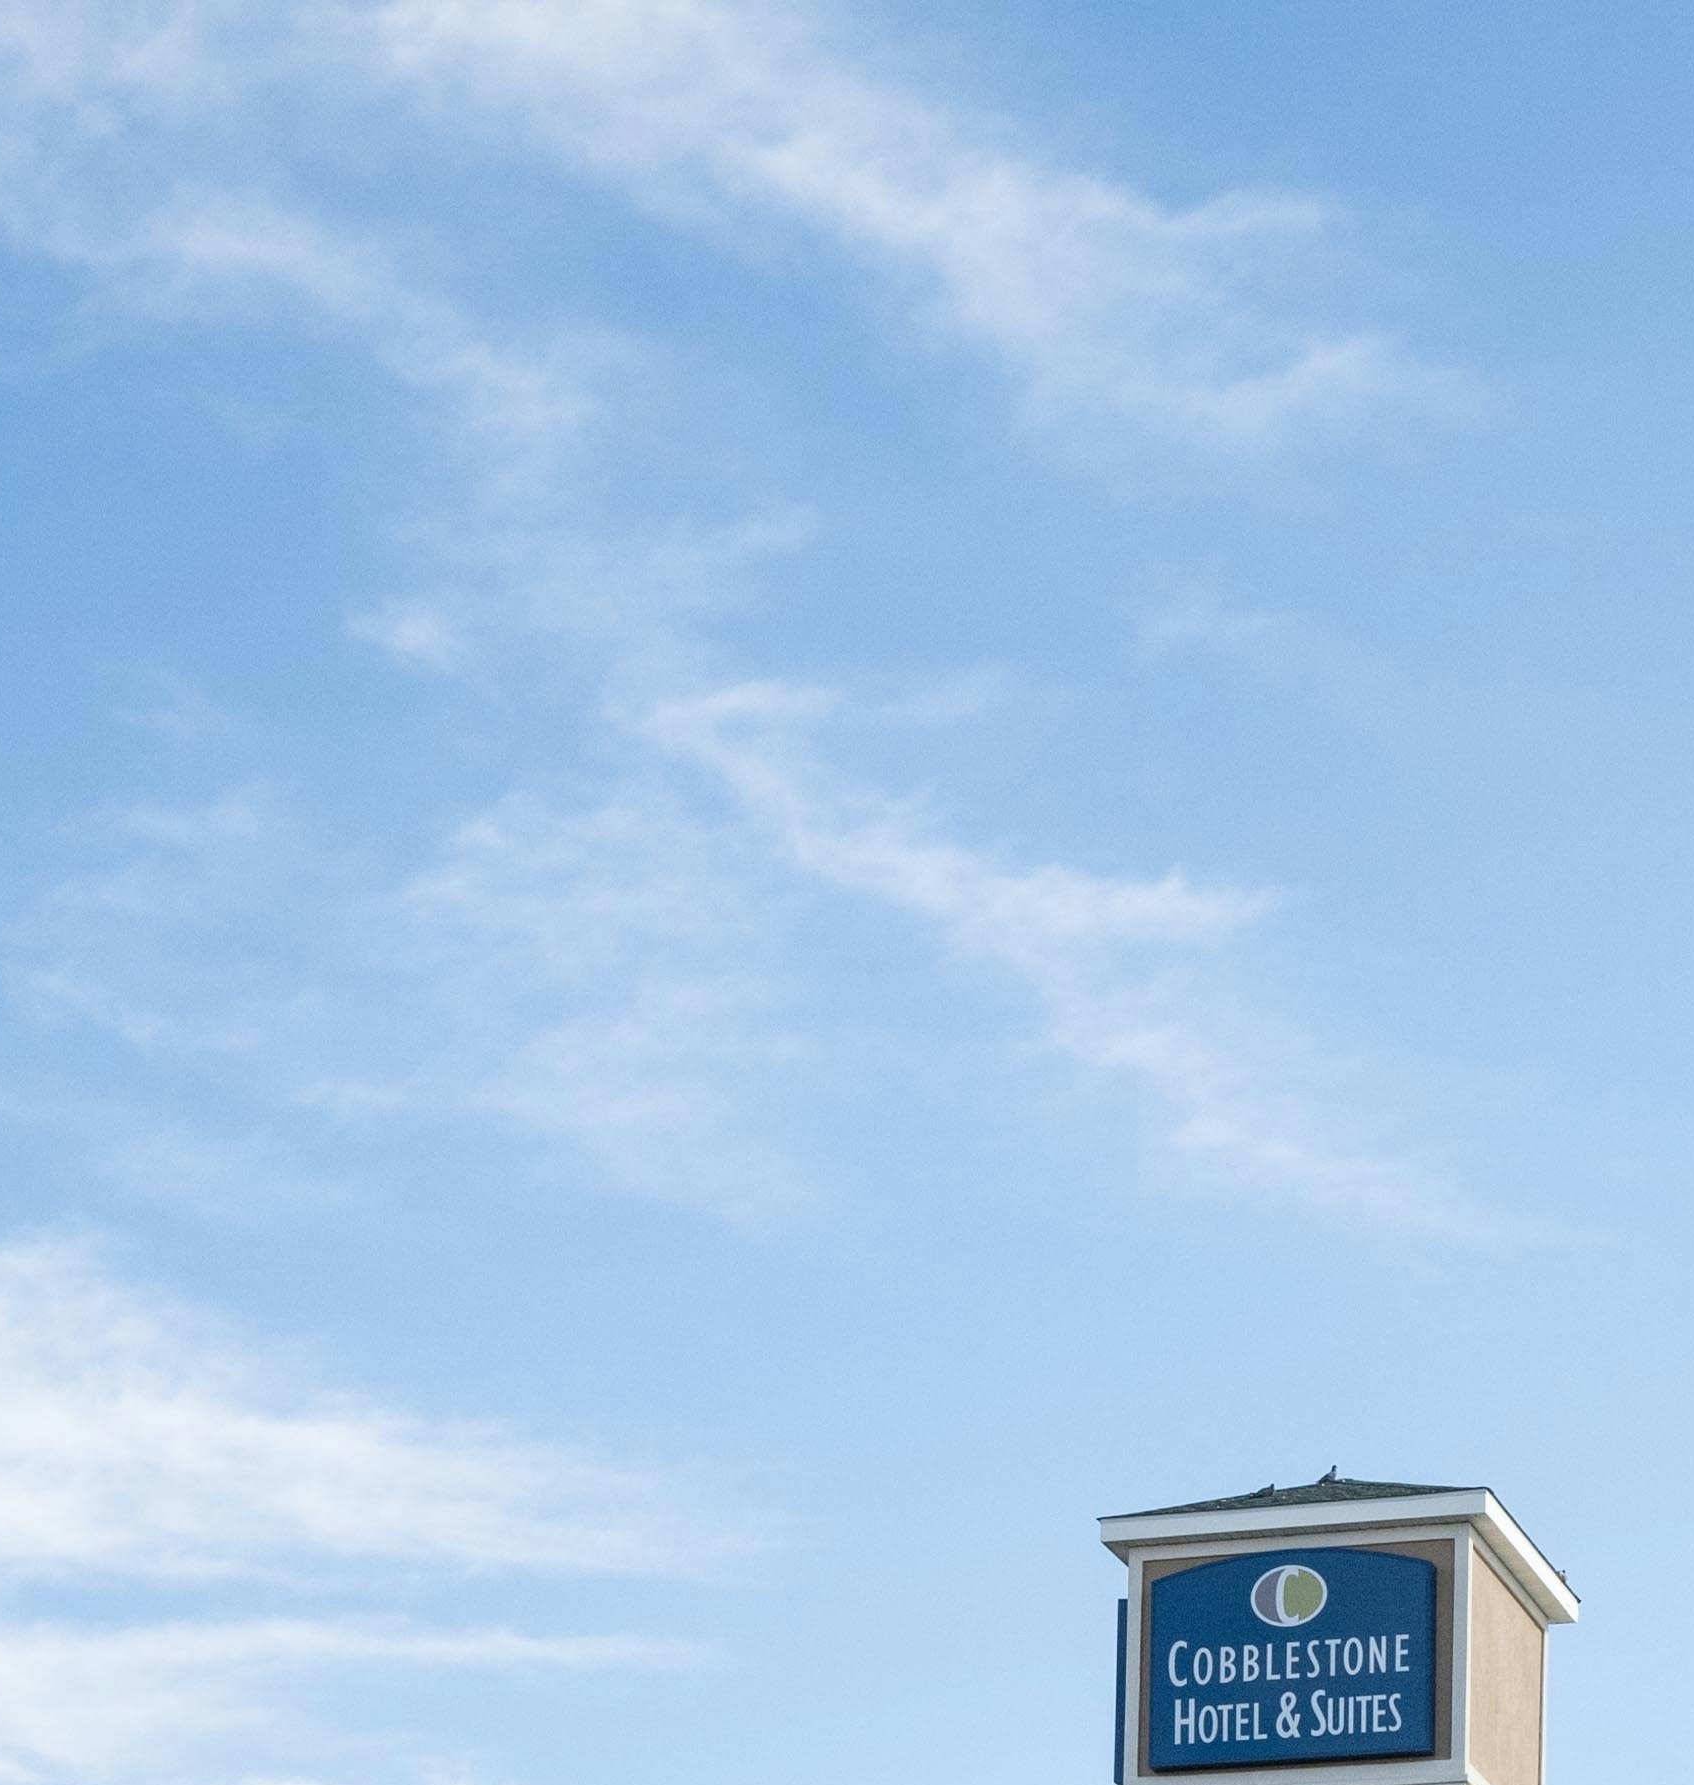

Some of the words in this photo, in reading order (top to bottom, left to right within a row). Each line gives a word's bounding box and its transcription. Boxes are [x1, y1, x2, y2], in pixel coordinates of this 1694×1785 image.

[1168, 1634, 1410, 1687] COBBLESTONE
[1174, 1698, 1268, 1745] HOTEL
[1276, 1691, 1301, 1739] &
[1311, 1689, 1402, 1737] SUITES
